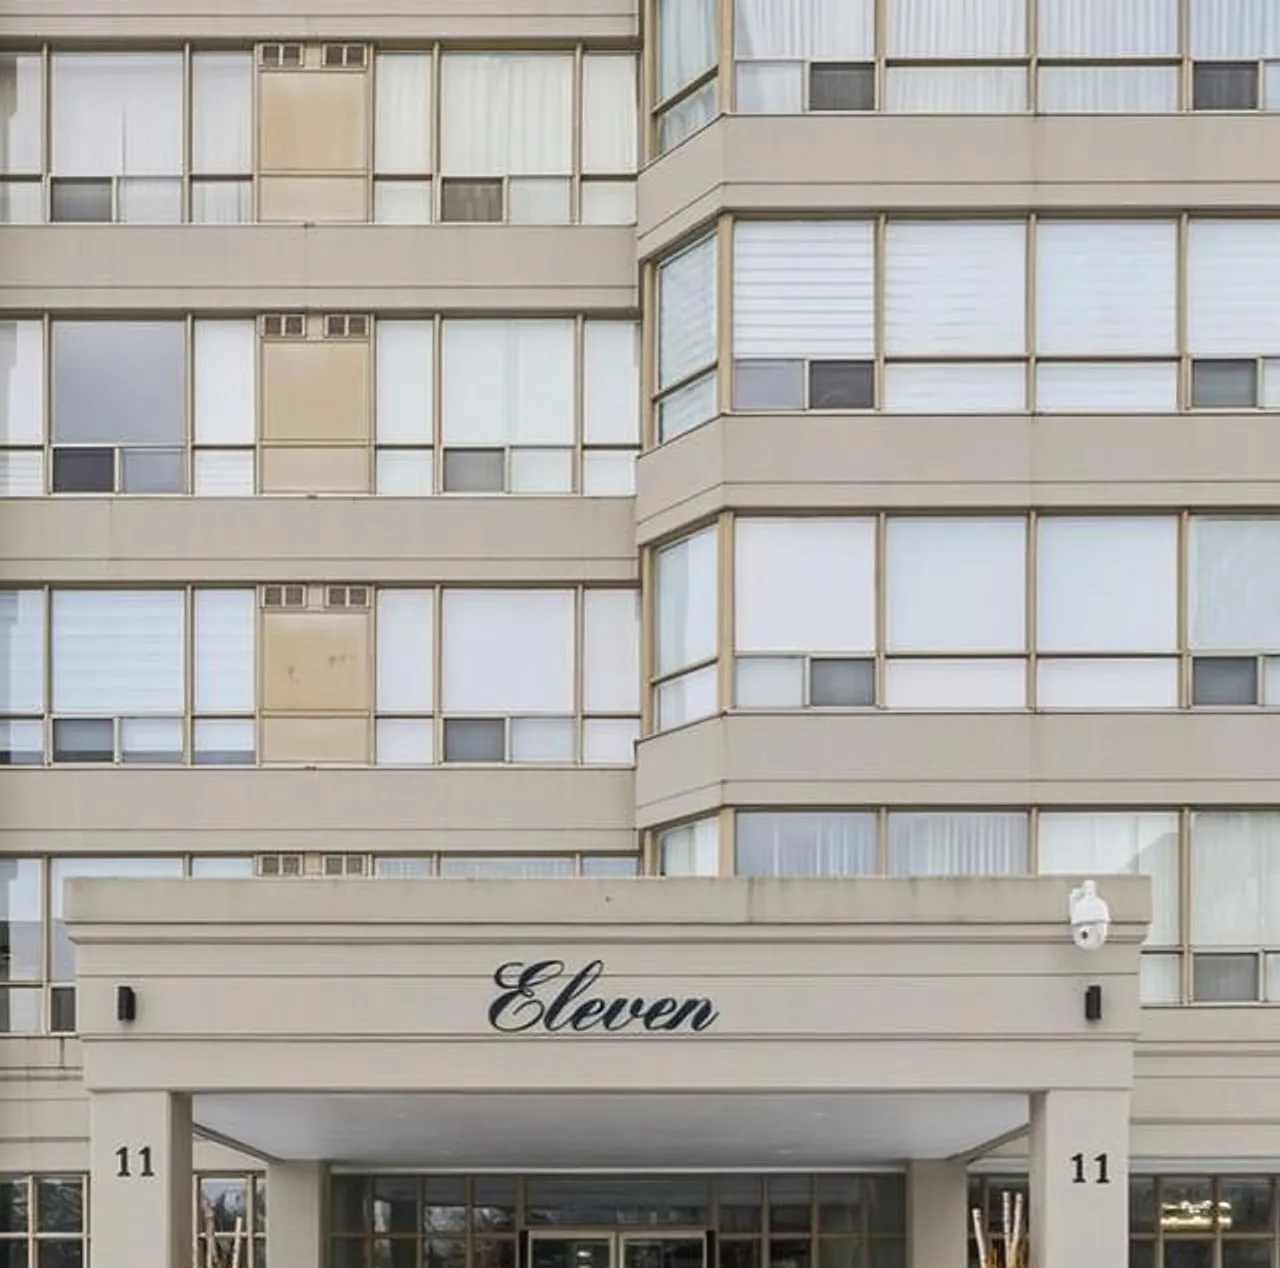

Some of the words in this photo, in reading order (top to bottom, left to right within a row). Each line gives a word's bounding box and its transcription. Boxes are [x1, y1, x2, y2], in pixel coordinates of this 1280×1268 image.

[488, 959, 720, 1032] Eleven
[115, 1146, 154, 1177] 11
[1071, 1153, 1110, 1184] 11
